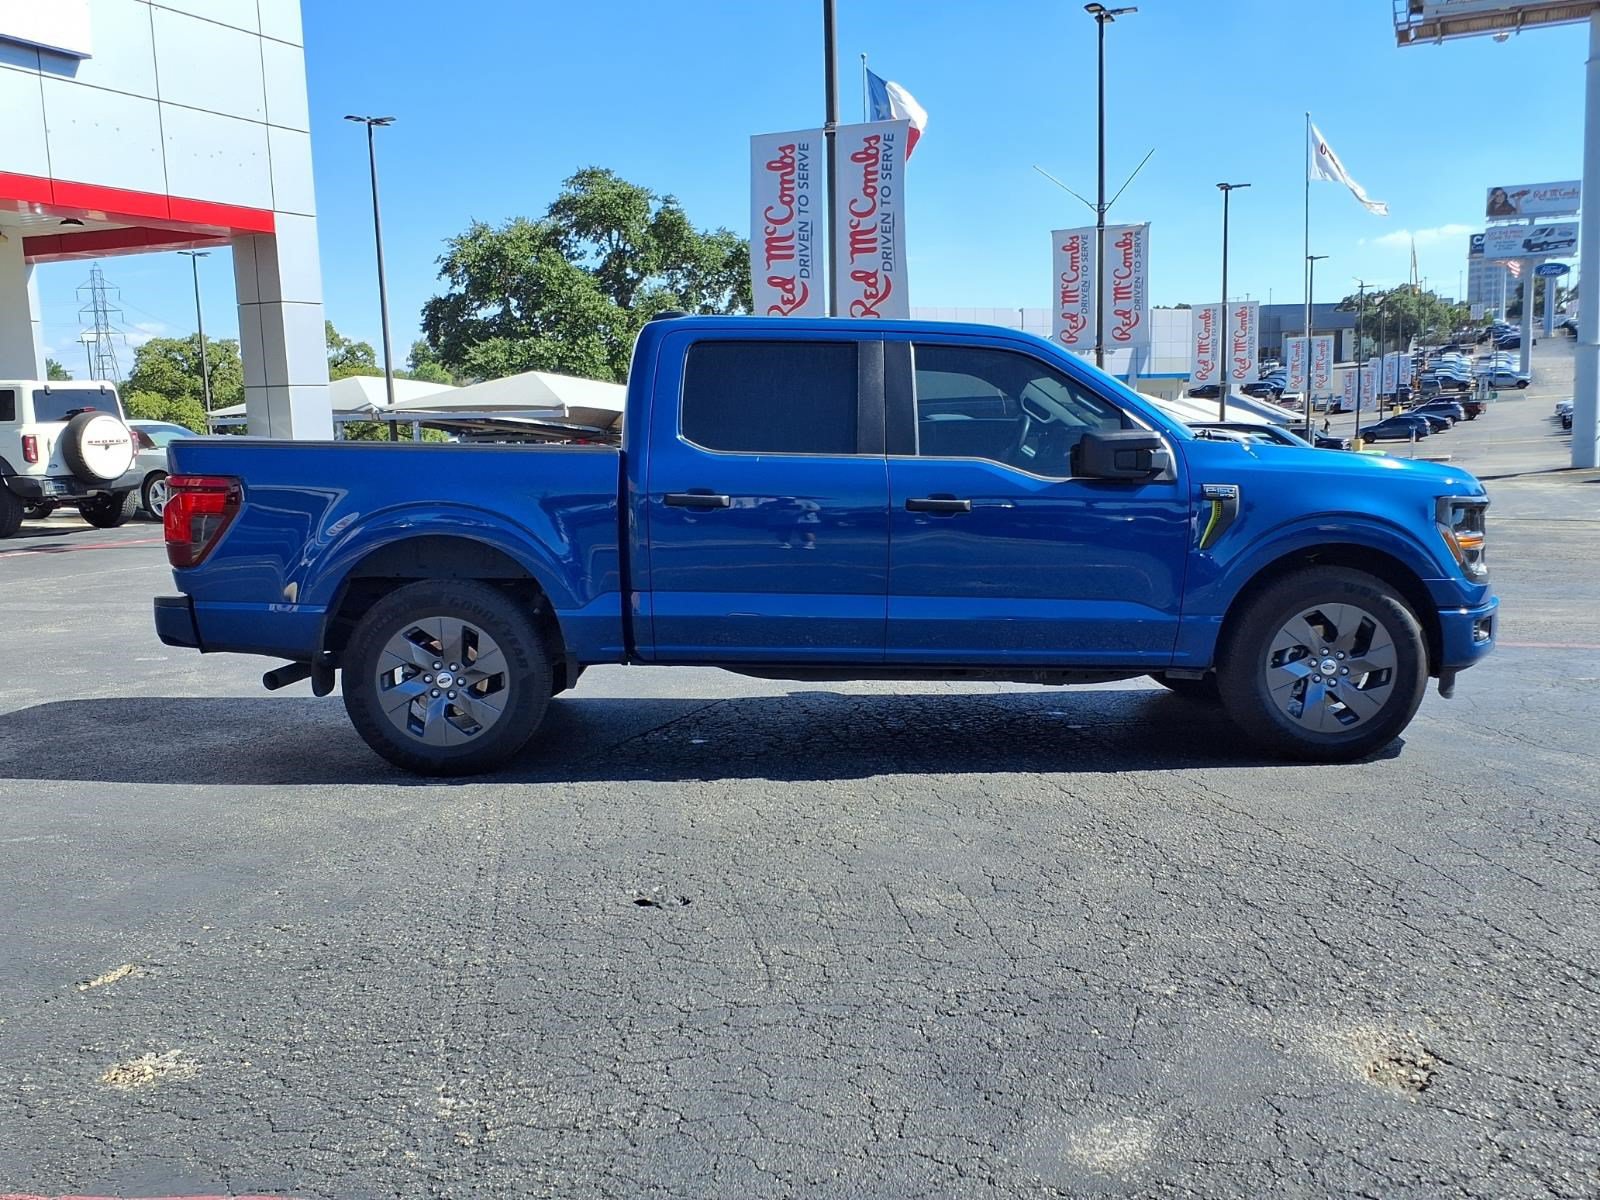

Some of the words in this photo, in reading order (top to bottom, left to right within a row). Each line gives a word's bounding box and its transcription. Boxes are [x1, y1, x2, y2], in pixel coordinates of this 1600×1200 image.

[798, 143, 809, 189] SERVE
[881, 133, 894, 179] SERVE
[764, 143, 796, 270] McCombs
[798, 193, 809, 215] TO
[849, 134, 881, 265] McCombs
[881, 185, 892, 207] TO
[798, 222, 810, 279] DRIVEN
[881, 213, 893, 272] DRIVEN
[1061, 235, 1080, 309] McCombs
[1081, 265, 1088, 278] TO
[1113, 231, 1133, 306] McCombs
[1134, 261, 1141, 273] TO
[767, 275, 809, 317] Red
[849, 269, 892, 318] Red
[1081, 281, 1089, 314] DRIVEN
[1059, 312, 1087, 344] Red
[1112, 309, 1140, 341] Red
[1197, 308, 1211, 358] McCombs
[1234, 306, 1247, 355] McCombs
[1195, 359, 1214, 380] Red
[1232, 357, 1251, 379] Red
